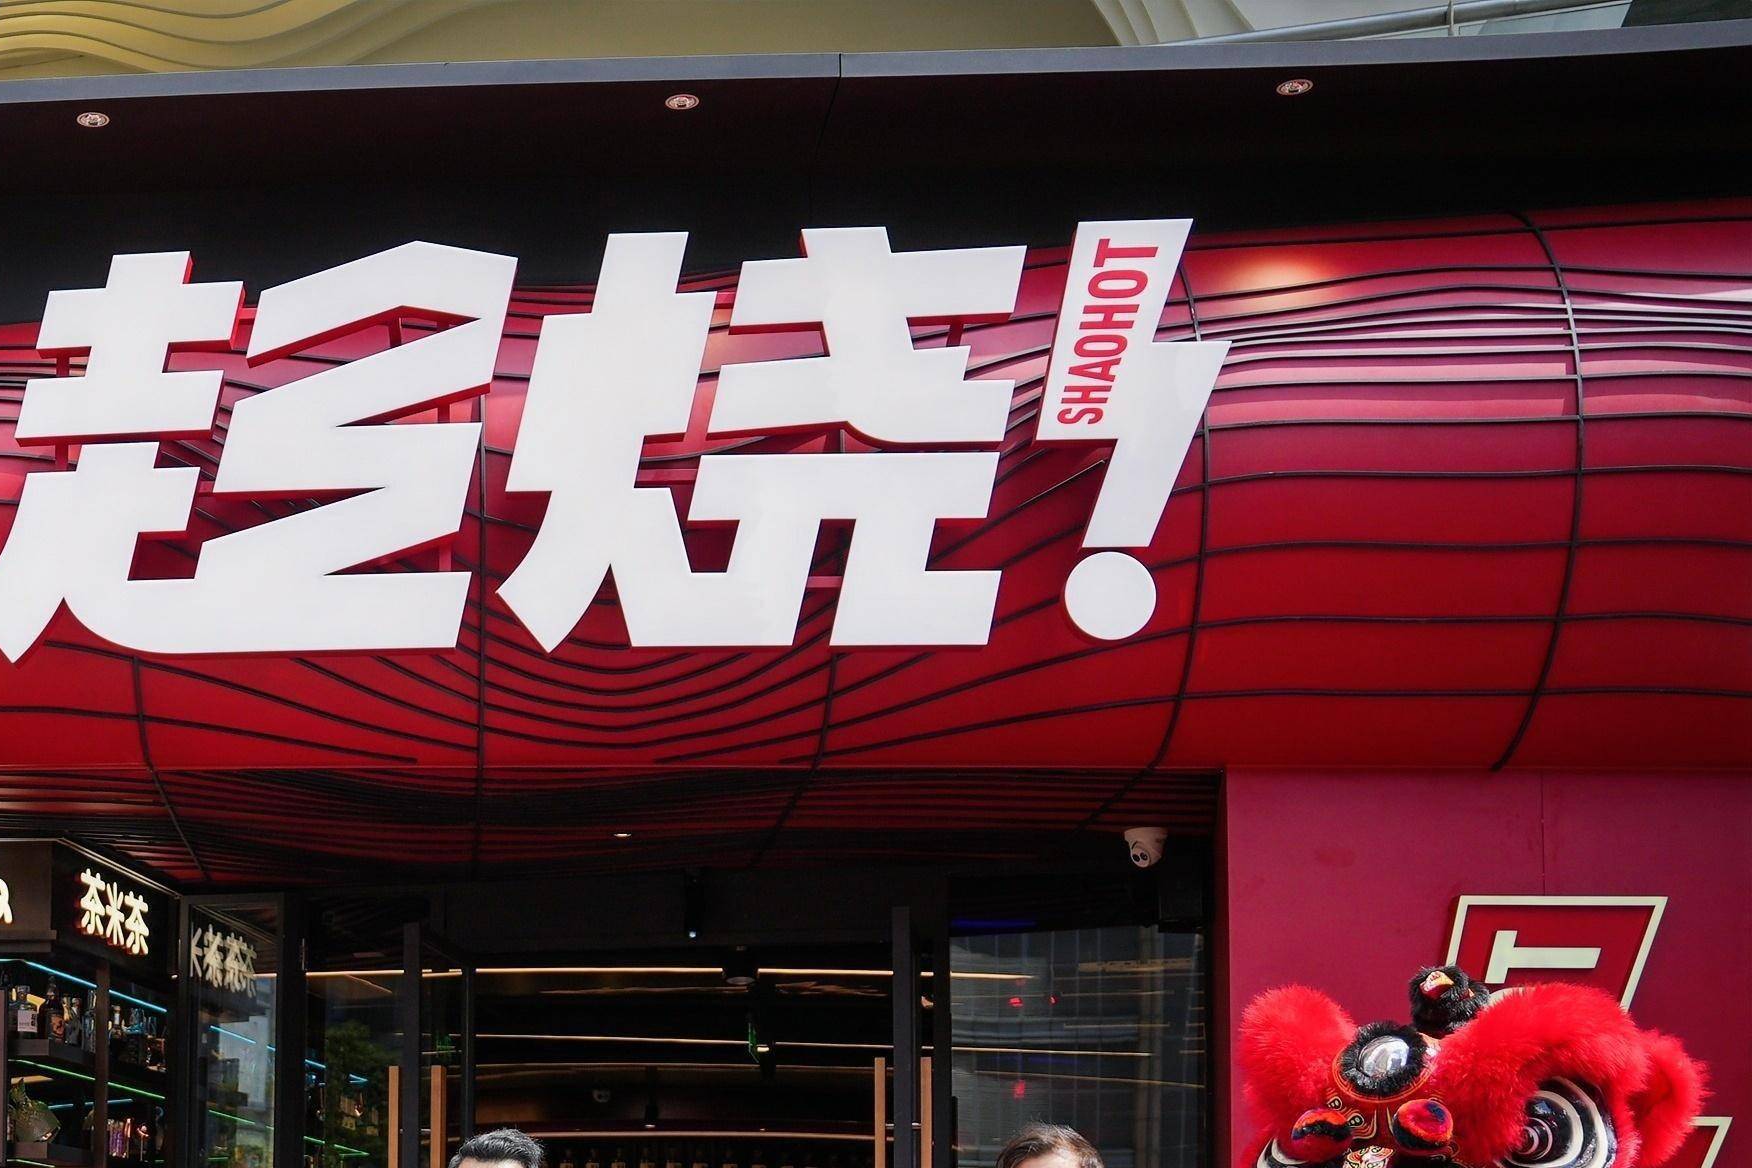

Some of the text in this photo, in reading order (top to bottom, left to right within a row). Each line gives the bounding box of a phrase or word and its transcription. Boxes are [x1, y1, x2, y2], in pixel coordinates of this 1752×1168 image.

[1055, 237, 1159, 424] SHAOHOT
[80, 868, 150, 955] 茶米茶
